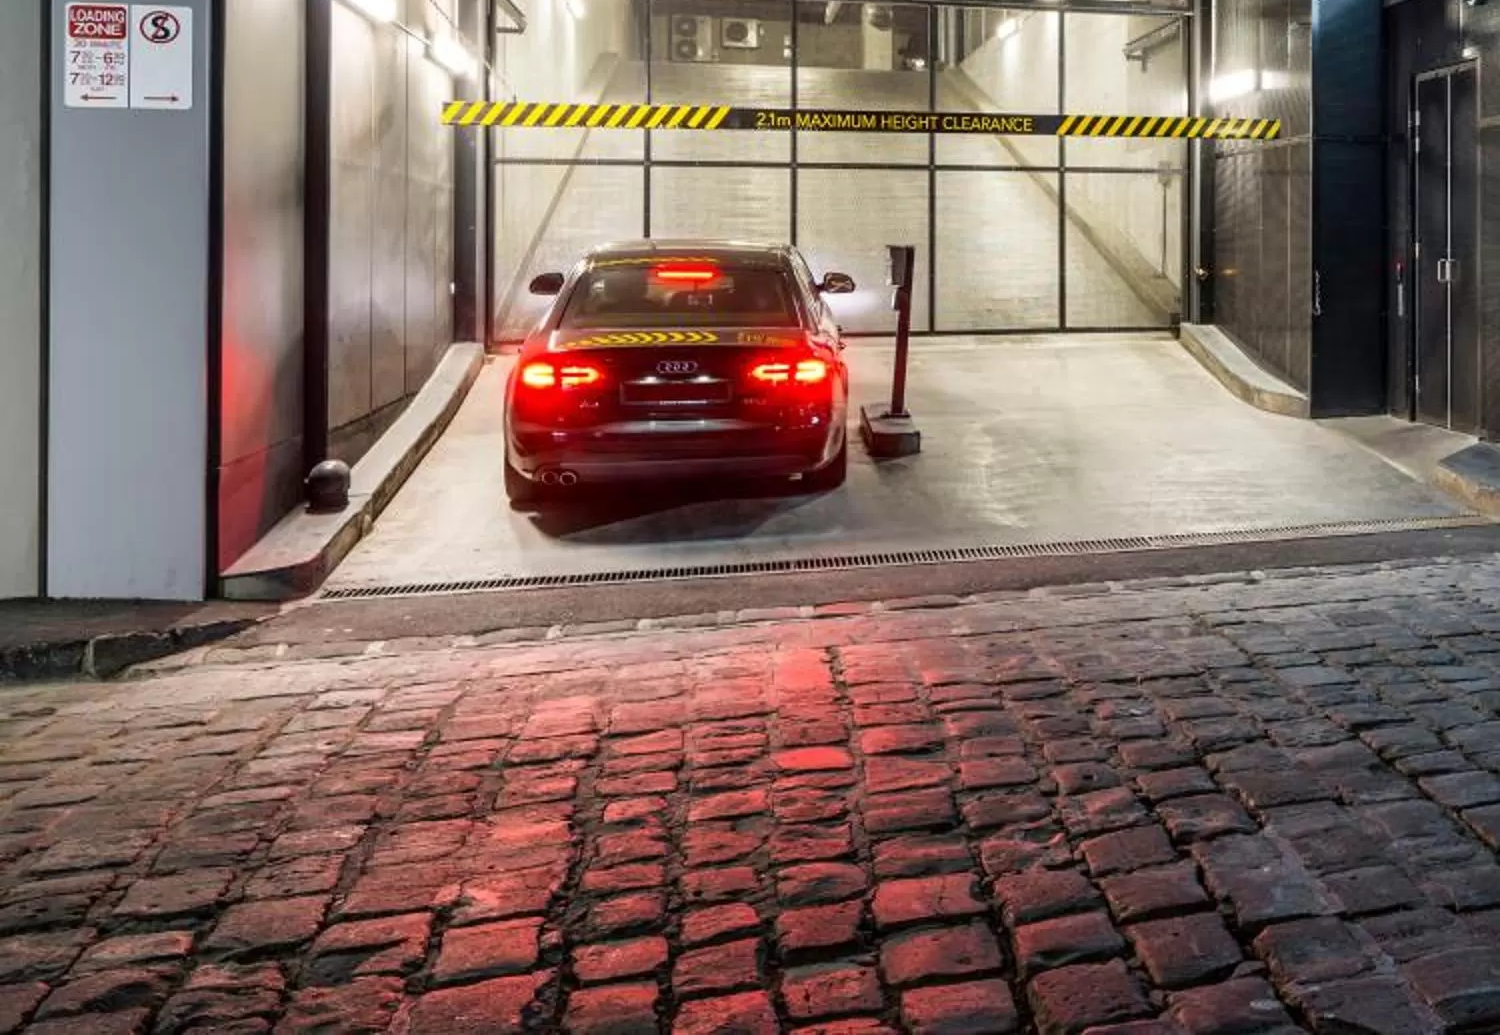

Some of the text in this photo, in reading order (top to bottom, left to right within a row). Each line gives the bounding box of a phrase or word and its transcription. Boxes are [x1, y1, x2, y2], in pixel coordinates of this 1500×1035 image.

[71, 8, 125, 23] LOADING
[73, 23, 123, 36] ZONE
[796, 114, 876, 129] MAXIMUM
[881, 115, 939, 131] HEIGHT
[942, 116, 1033, 133] CLEARANCE
